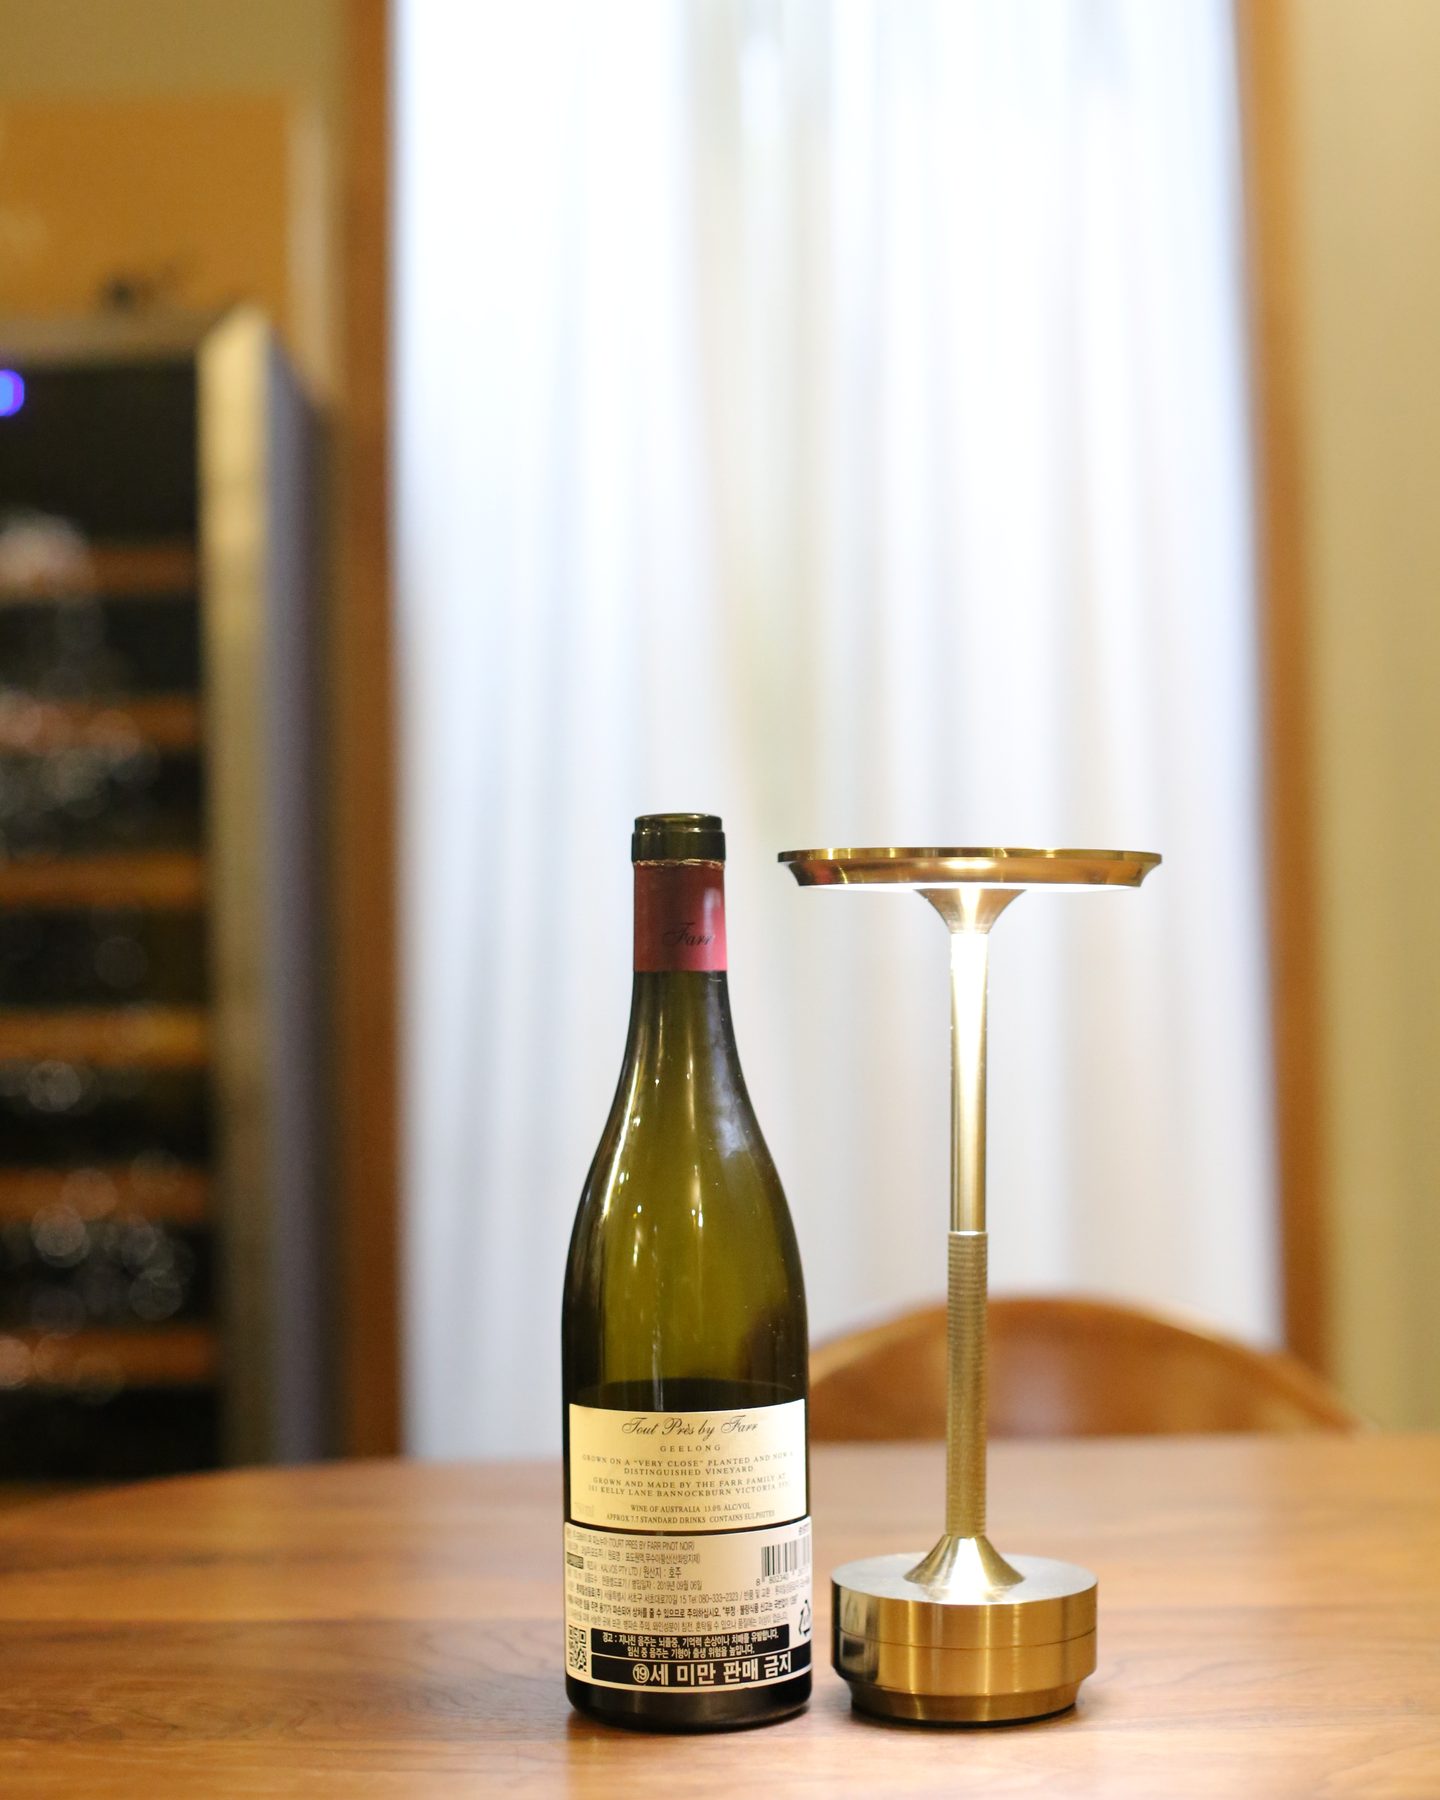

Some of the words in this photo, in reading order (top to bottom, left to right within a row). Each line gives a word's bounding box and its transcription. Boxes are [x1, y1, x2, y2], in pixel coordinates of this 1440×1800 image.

[663, 922, 713, 945] Farr
[621, 1417, 660, 1435] Tout
[661, 1417, 694, 1436] Près
[698, 1419, 716, 1442] by
[720, 1414, 759, 1434] Farr
[659, 1444, 721, 1453] GEELONG
[582, 1454, 607, 1464] GROWN
[609, 1457, 622, 1465] ON
[708, 1457, 751, 1467] PLANTED
[753, 1454, 771, 1463] AND
[624, 1467, 702, 1477] DISTINGUISHED
[705, 1465, 754, 1475] VINEYARD
[592, 1476, 622, 1486] GROWN
[624, 1480, 644, 1488] AND
[647, 1481, 676, 1489] MADE
[679, 1481, 692, 1489] BY
[696, 1480, 716, 1488] THE
[719, 1478, 743, 1487] FARR
[746, 1474, 776, 1485] FAMILY
[600, 1486, 626, 1496] KELLY
[628, 1489, 653, 1497] LANE
[656, 1487, 732, 1498] BANNOCKBURN
[735, 1483, 776, 1495] VICTORIA
[630, 1504, 648, 1513] WINE
[649, 1505, 659, 1513] OF
[660, 1505, 701, 1514] AUSTRALIA
[723, 1502, 752, 1512] ALC/VOL
[640, 1516, 678, 1525] STANDARD
[679, 1515, 706, 1524] DRINKS
[709, 1513, 744, 1524] CONTAINS
[639, 1540, 646, 1551] BY
[647, 1541, 661, 1551] FARR
[662, 1541, 679, 1551] PINOT
[643, 1565, 662, 1579] 원산지
[668, 1566, 682, 1579] 호주
[755, 1578, 761, 1587] 8
[680, 1594, 687, 1604] 15
[632, 1606, 647, 1618] 상처를
[656, 1608, 662, 1619] 수
[663, 1608, 686, 1619] 있으므로
[713, 1619, 720, 1630] 수
[720, 1619, 737, 1630] 있으나
[602, 1631, 613, 1643] 경고
[618, 1633, 636, 1646] 지나친
[637, 1635, 657, 1648] 음주는
[682, 1636, 703, 1648] 기억력
[704, 1635, 730, 1647] 손상이나
[731, 1632, 750, 1645] 치매를
[627, 1646, 640, 1658] 임신
[640, 1647, 648, 1658] 중
[649, 1647, 669, 1659] 음주는
[671, 1648, 691, 1660] 기형아
[693, 1647, 707, 1659] 출생
[708, 1646, 727, 1658] 위험을
[676, 1662, 717, 1686] 미만
[723, 1658, 759, 1684] 판매
[763, 1650, 792, 1679] 금지
